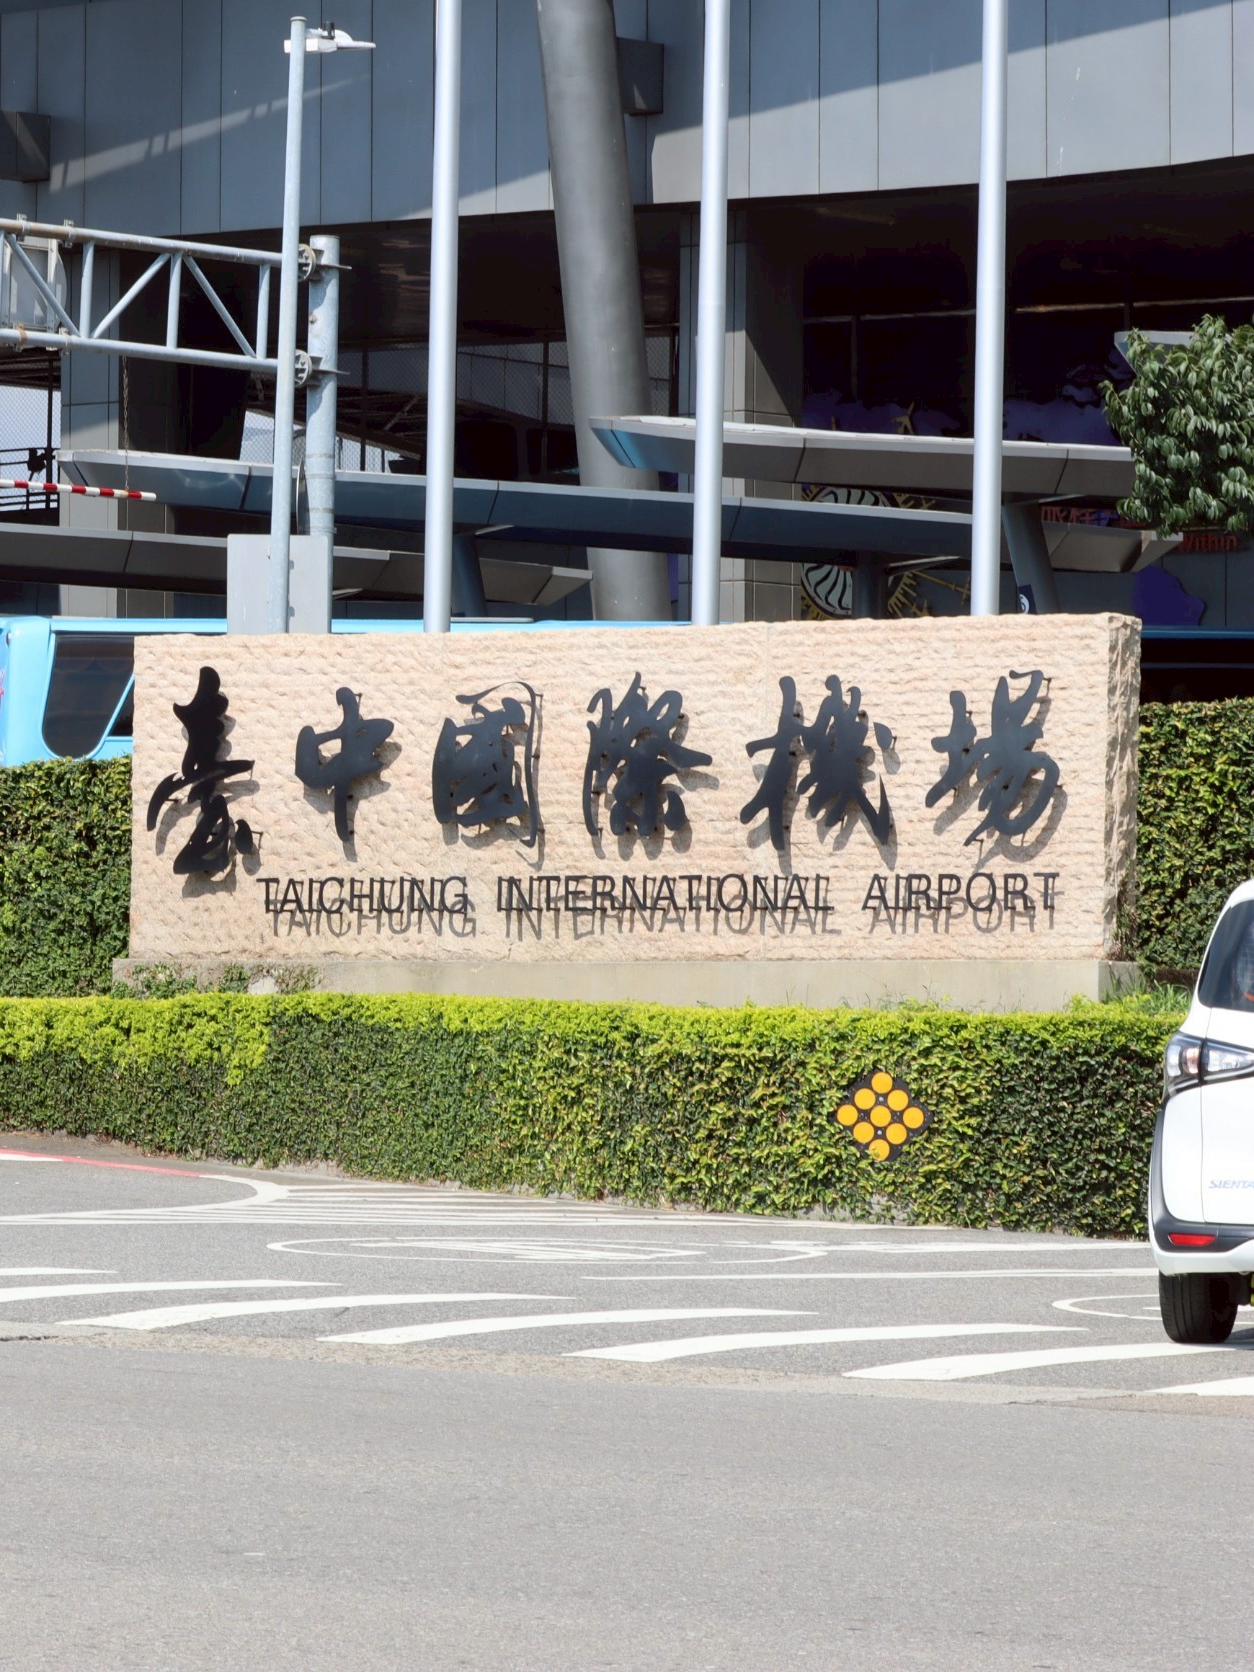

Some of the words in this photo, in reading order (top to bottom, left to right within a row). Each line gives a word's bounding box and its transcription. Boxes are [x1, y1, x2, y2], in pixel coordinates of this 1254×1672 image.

[147, 666, 1060, 876] 臺中國際機場
[257, 877, 468, 915] TAICHUNG
[497, 875, 833, 913] INTERNATIONAL
[863, 873, 1060, 911] AIRPORT
